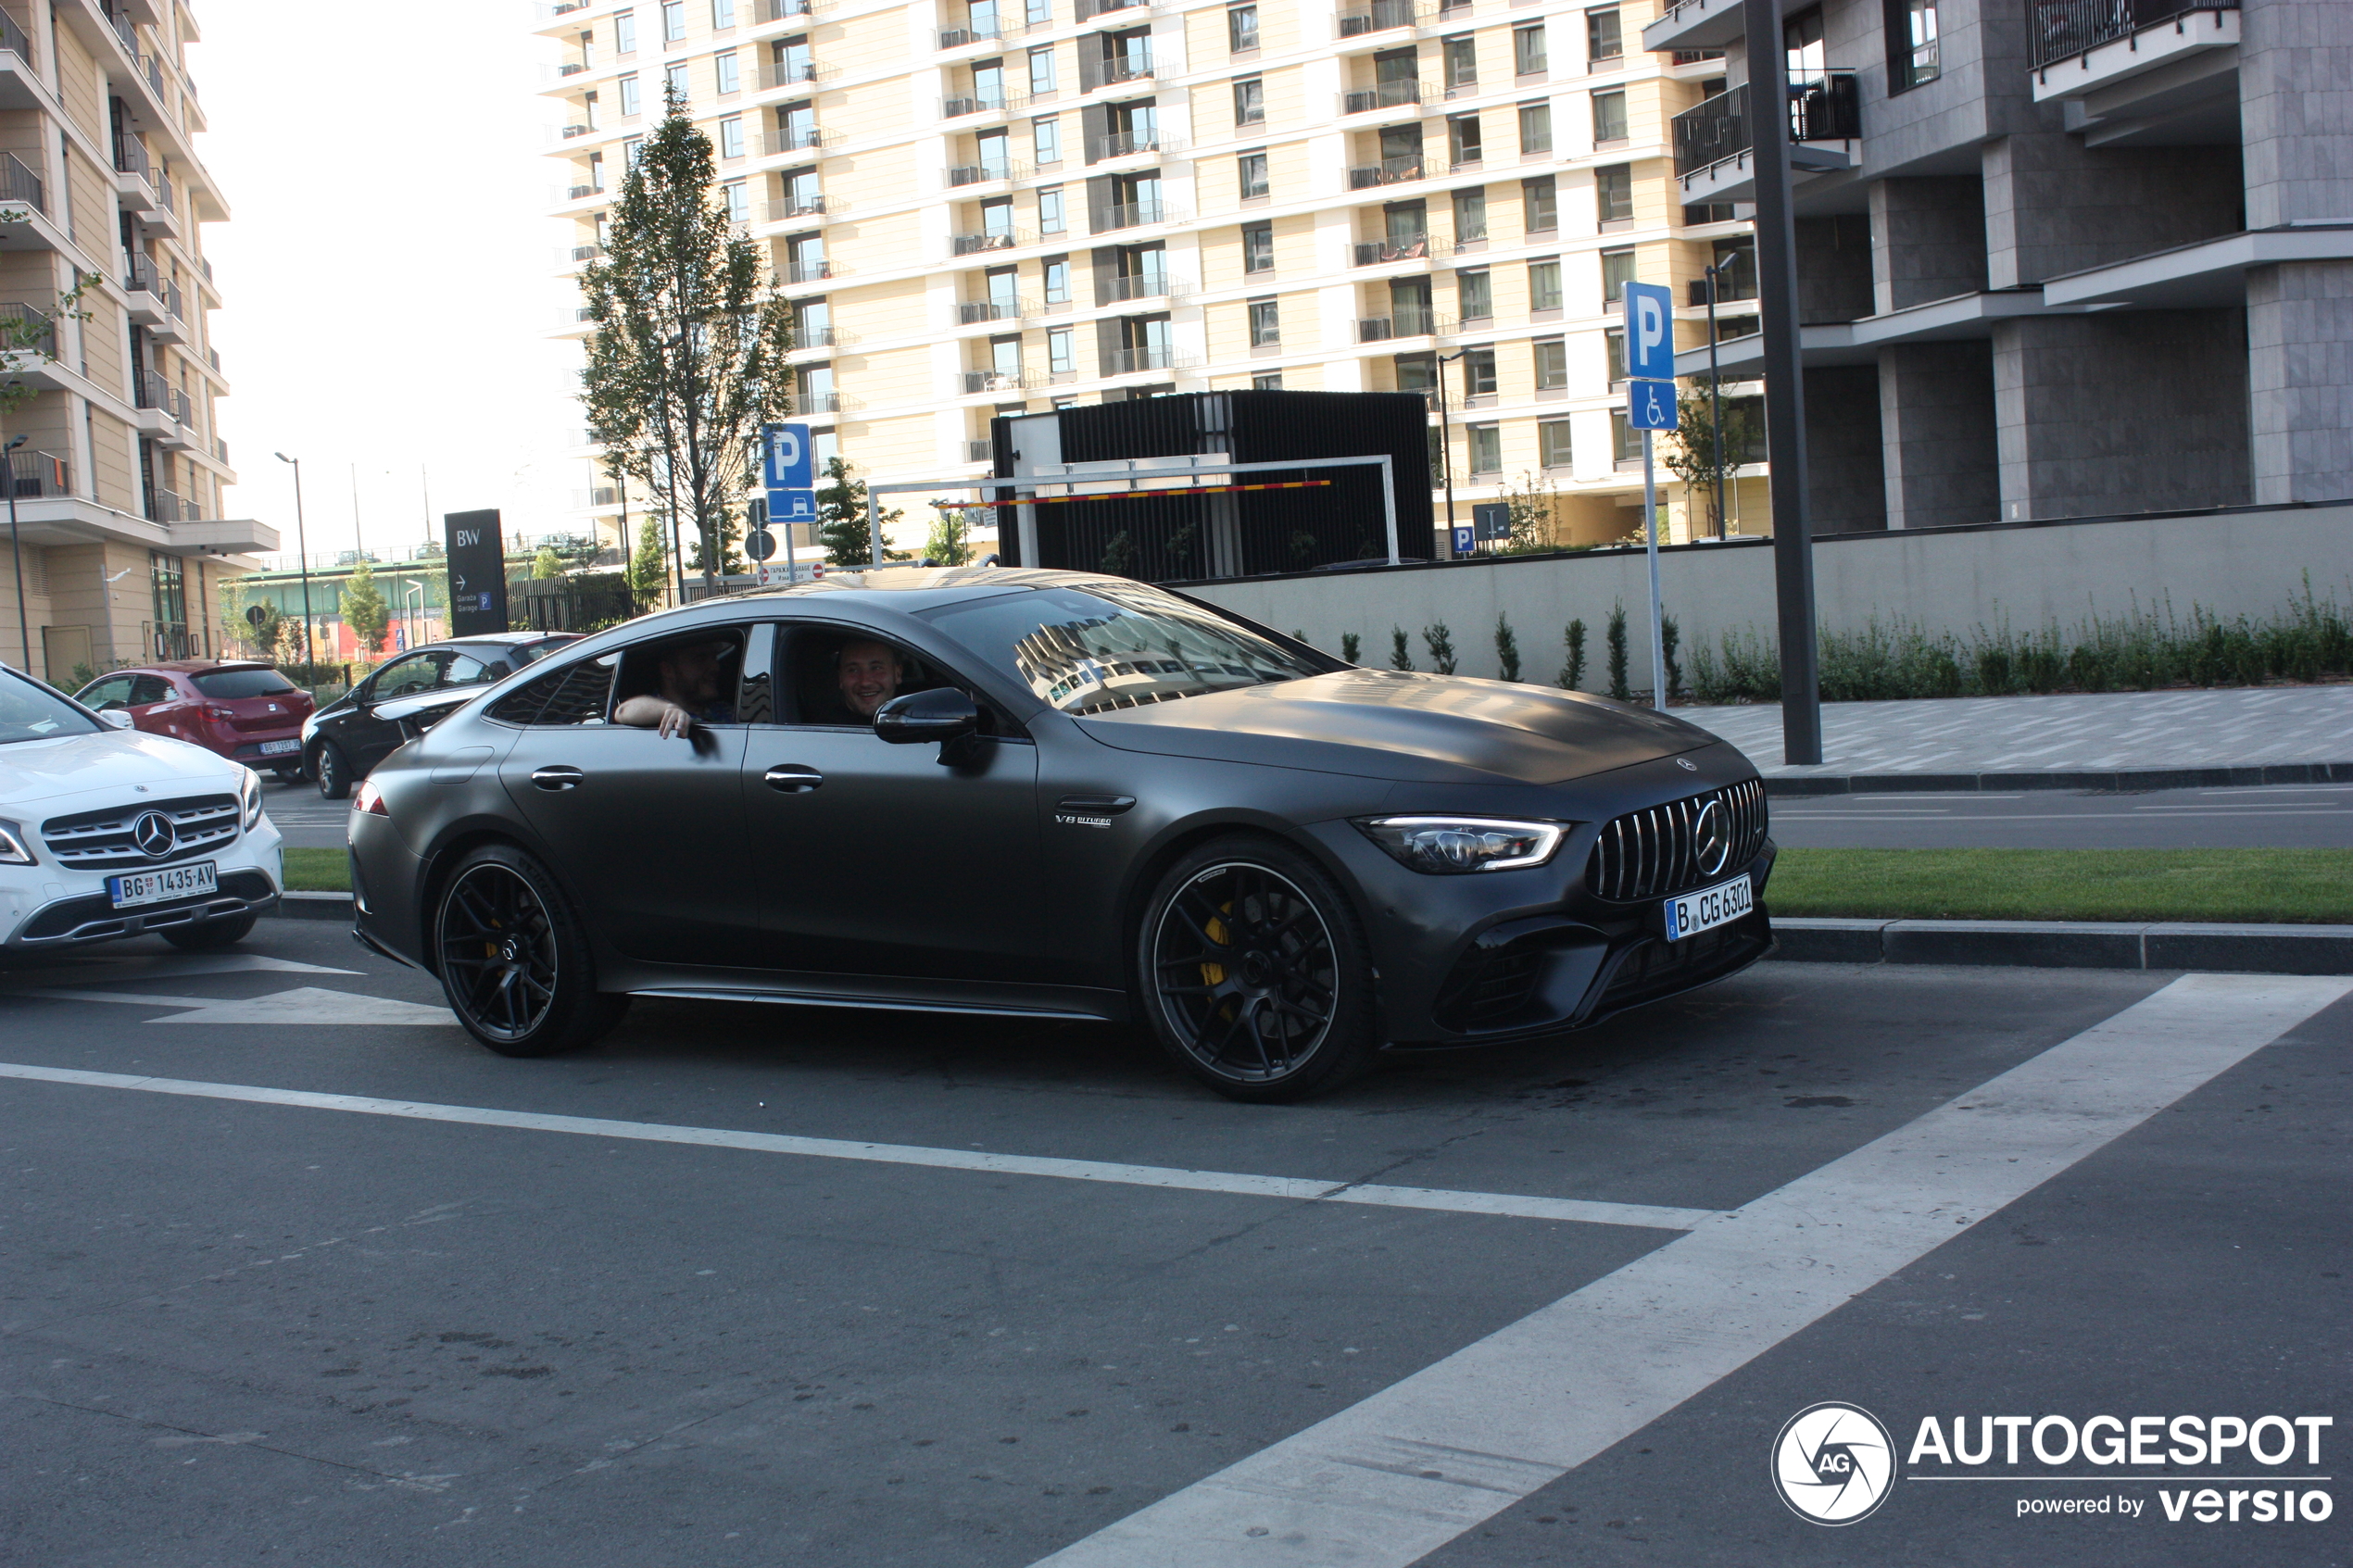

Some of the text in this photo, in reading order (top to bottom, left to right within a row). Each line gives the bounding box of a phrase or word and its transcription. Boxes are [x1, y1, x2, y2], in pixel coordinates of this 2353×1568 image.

[1637, 295, 1663, 366] P
[773, 432, 800, 480] P
[457, 529, 480, 546] BW
[1457, 529, 1469, 549] P
[1055, 814, 1076, 824] V8
[123, 878, 145, 898] BG
[1677, 879, 1752, 933] B CG 6301
[1670, 925, 1675, 935] D
